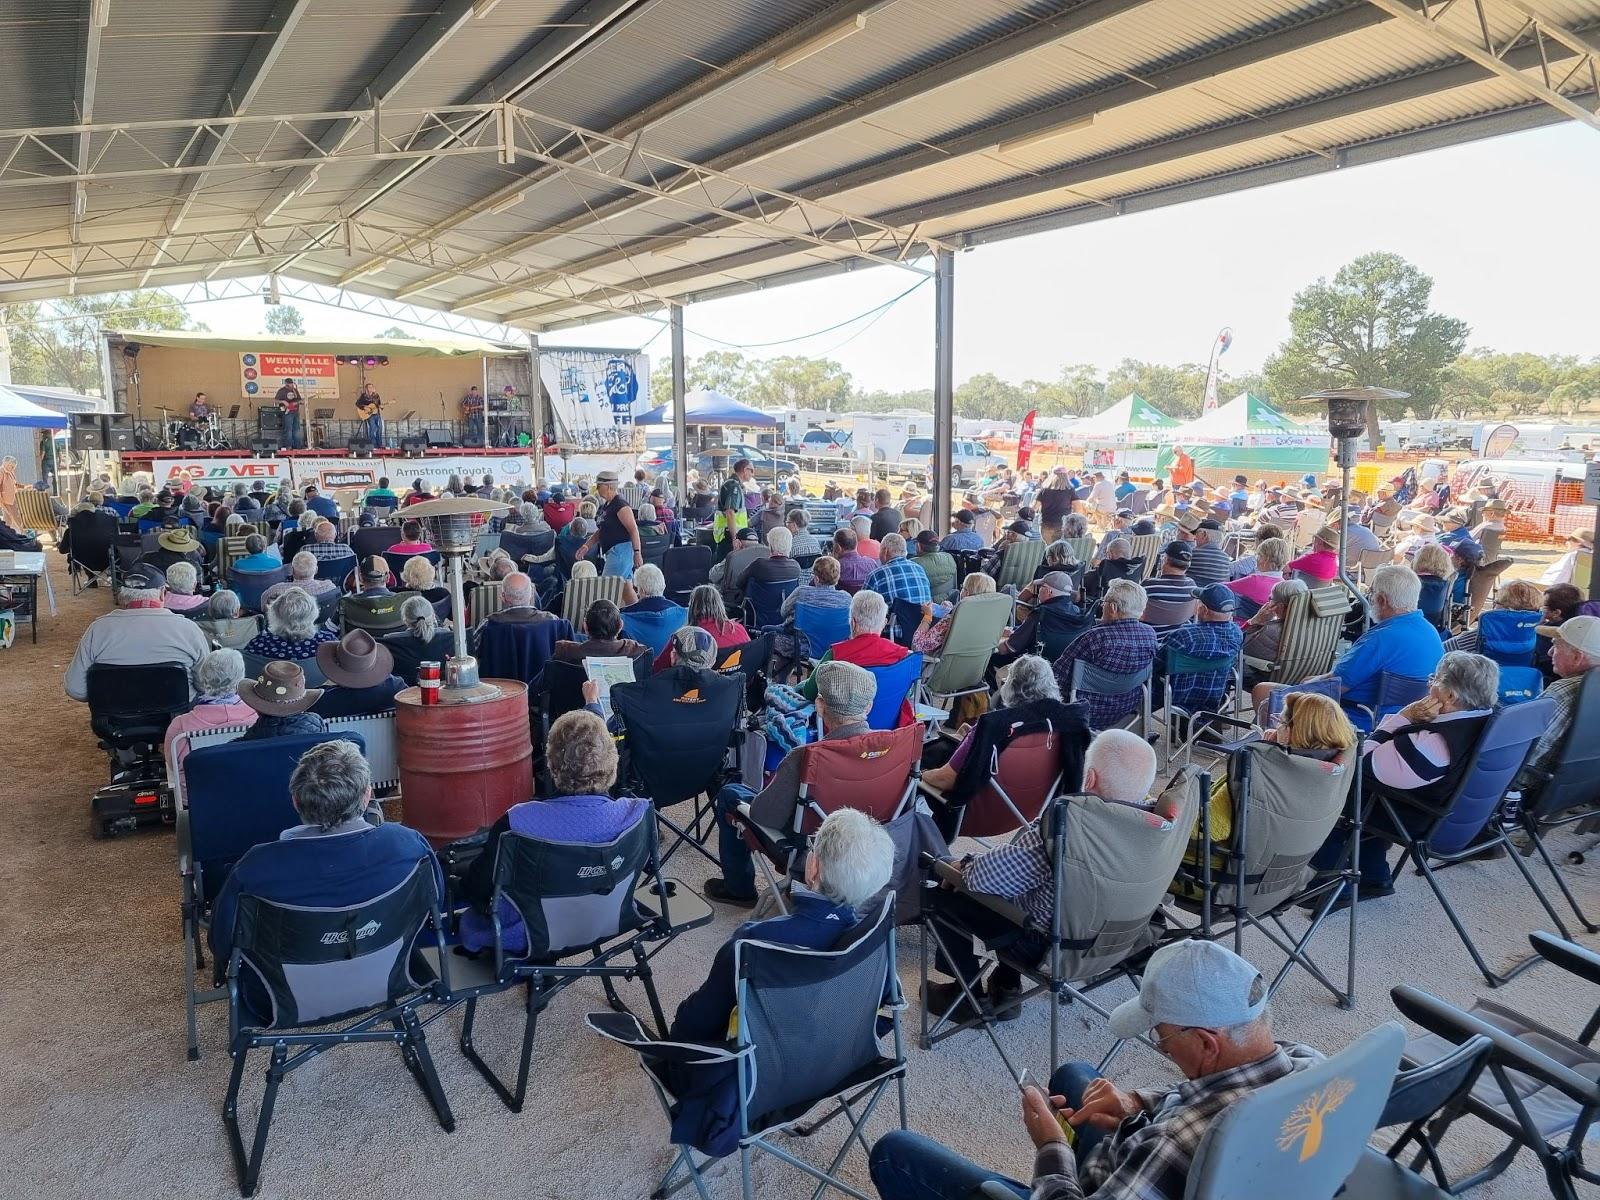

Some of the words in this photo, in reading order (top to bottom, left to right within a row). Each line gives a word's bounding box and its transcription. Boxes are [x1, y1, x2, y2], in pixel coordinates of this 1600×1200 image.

[265, 356, 329, 365] WEETHALLE
[273, 366, 323, 374] COUNTRY
[457, 466, 493, 475] Toyota
[325, 475, 372, 484] AKUBRA
